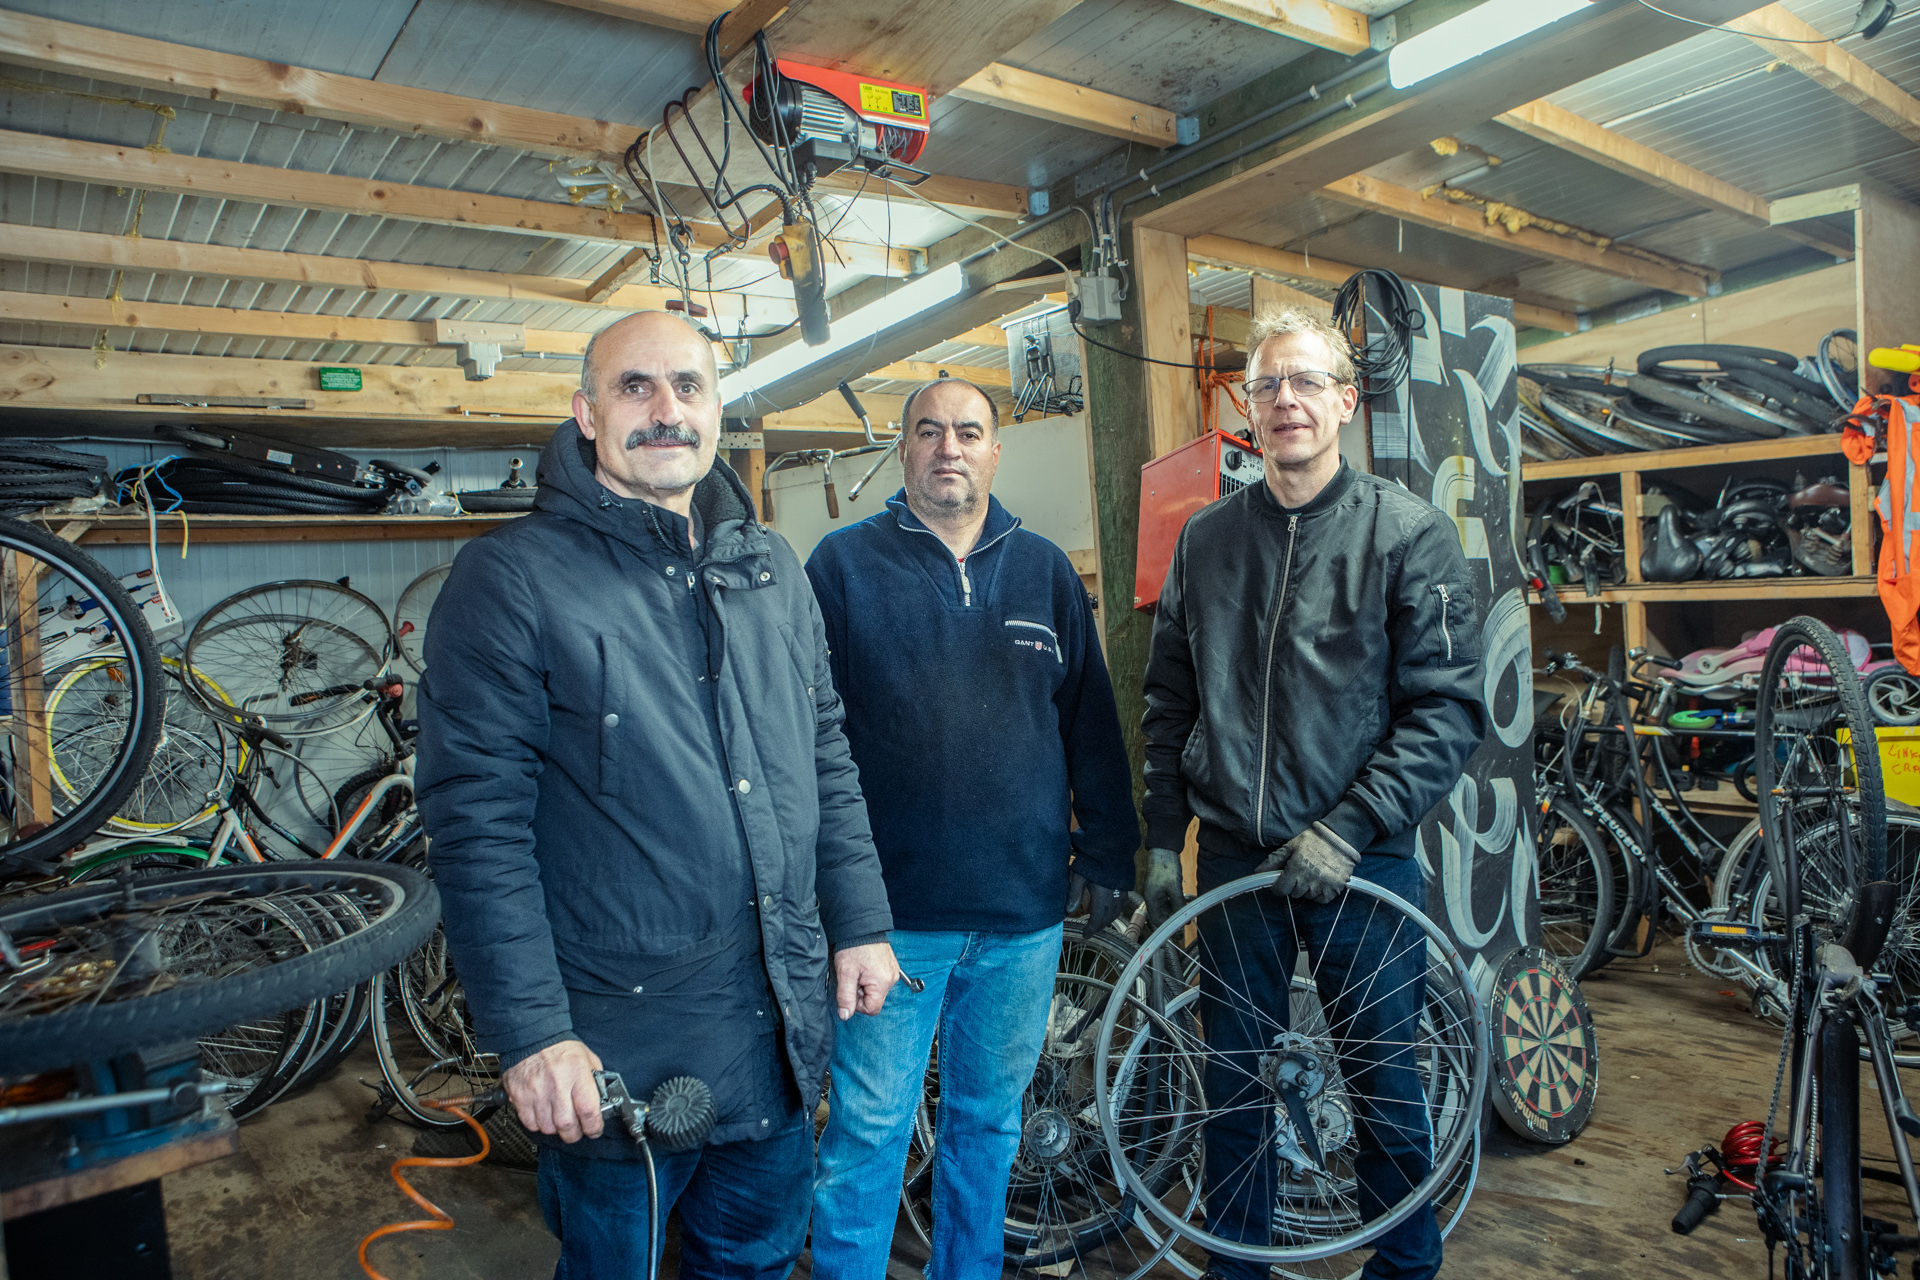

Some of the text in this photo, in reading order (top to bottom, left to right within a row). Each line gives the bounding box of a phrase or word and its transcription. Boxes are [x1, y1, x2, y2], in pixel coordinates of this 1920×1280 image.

[1165, 118, 1171, 132] 6
[1208, 111, 1217, 127] 6
[1015, 192, 1022, 204] 5
[898, 255, 906, 266] 4
[1014, 639, 1035, 647] GANT
